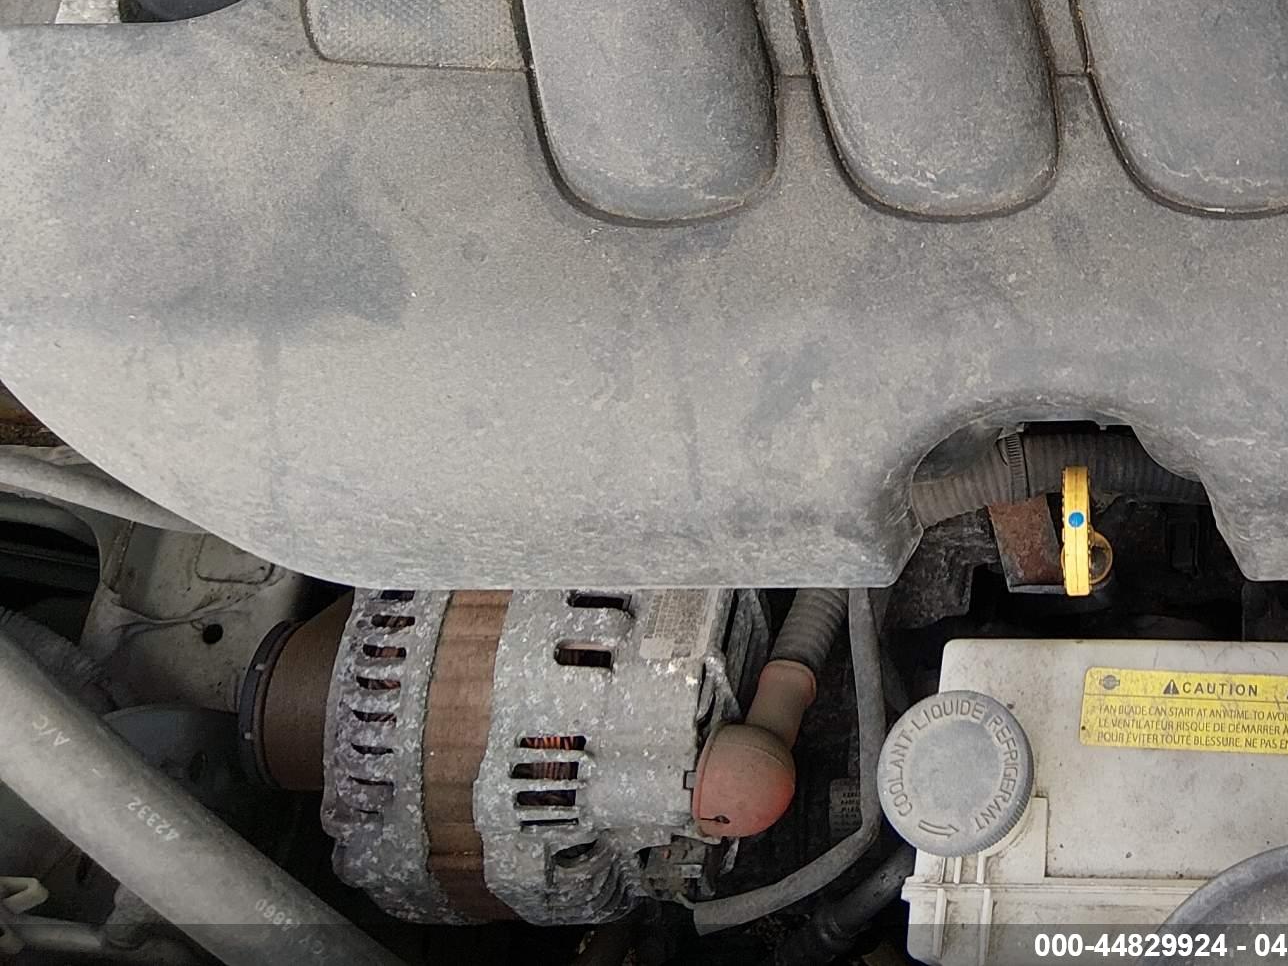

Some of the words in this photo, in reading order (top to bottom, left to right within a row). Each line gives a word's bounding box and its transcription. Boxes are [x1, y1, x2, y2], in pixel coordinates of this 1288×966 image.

[1182, 681, 1258, 696] CAUTION
[1118, 705, 1147, 715] BLADE
[1148, 706, 1168, 716] CAN
[1168, 707, 1195, 718] START
[1196, 708, 1208, 718] AT
[1209, 709, 1228, 719] ANY
[1252, 710, 1265, 720] TO
[32, 716, 70, 748] A/C
[1098, 717, 1109, 728] LE
[1111, 718, 1174, 731] VENTILATEUR
[1176, 721, 1210, 732] RISQUE
[1213, 722, 1225, 732] DE
[1097, 731, 1124, 742] POUR
[1245, 738, 1258, 747] NE
[1260, 738, 1277, 749] PAS
[975, 716, 1019, 831] REFRIGERANT
[127, 796, 180, 842] 42332
